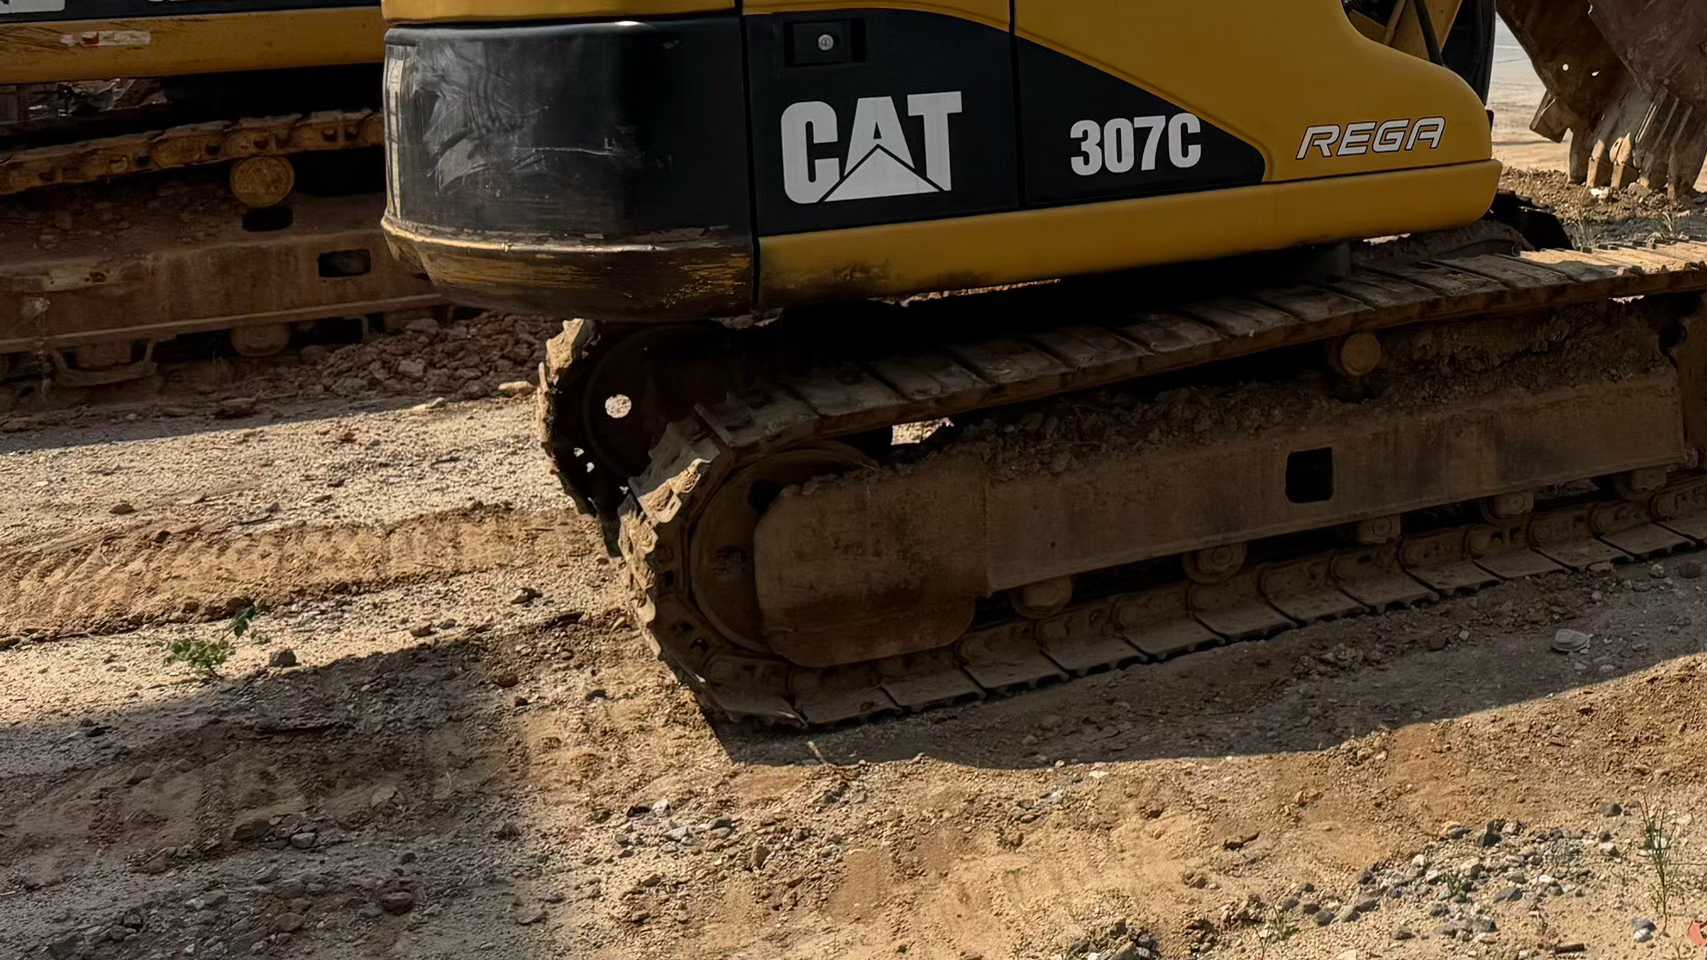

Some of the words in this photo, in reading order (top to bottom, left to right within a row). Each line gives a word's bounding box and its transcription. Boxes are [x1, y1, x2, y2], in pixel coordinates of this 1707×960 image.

[780, 91, 963, 204] CAT
[1069, 112, 1202, 176] 307C
[1295, 116, 1446, 160] REGA
